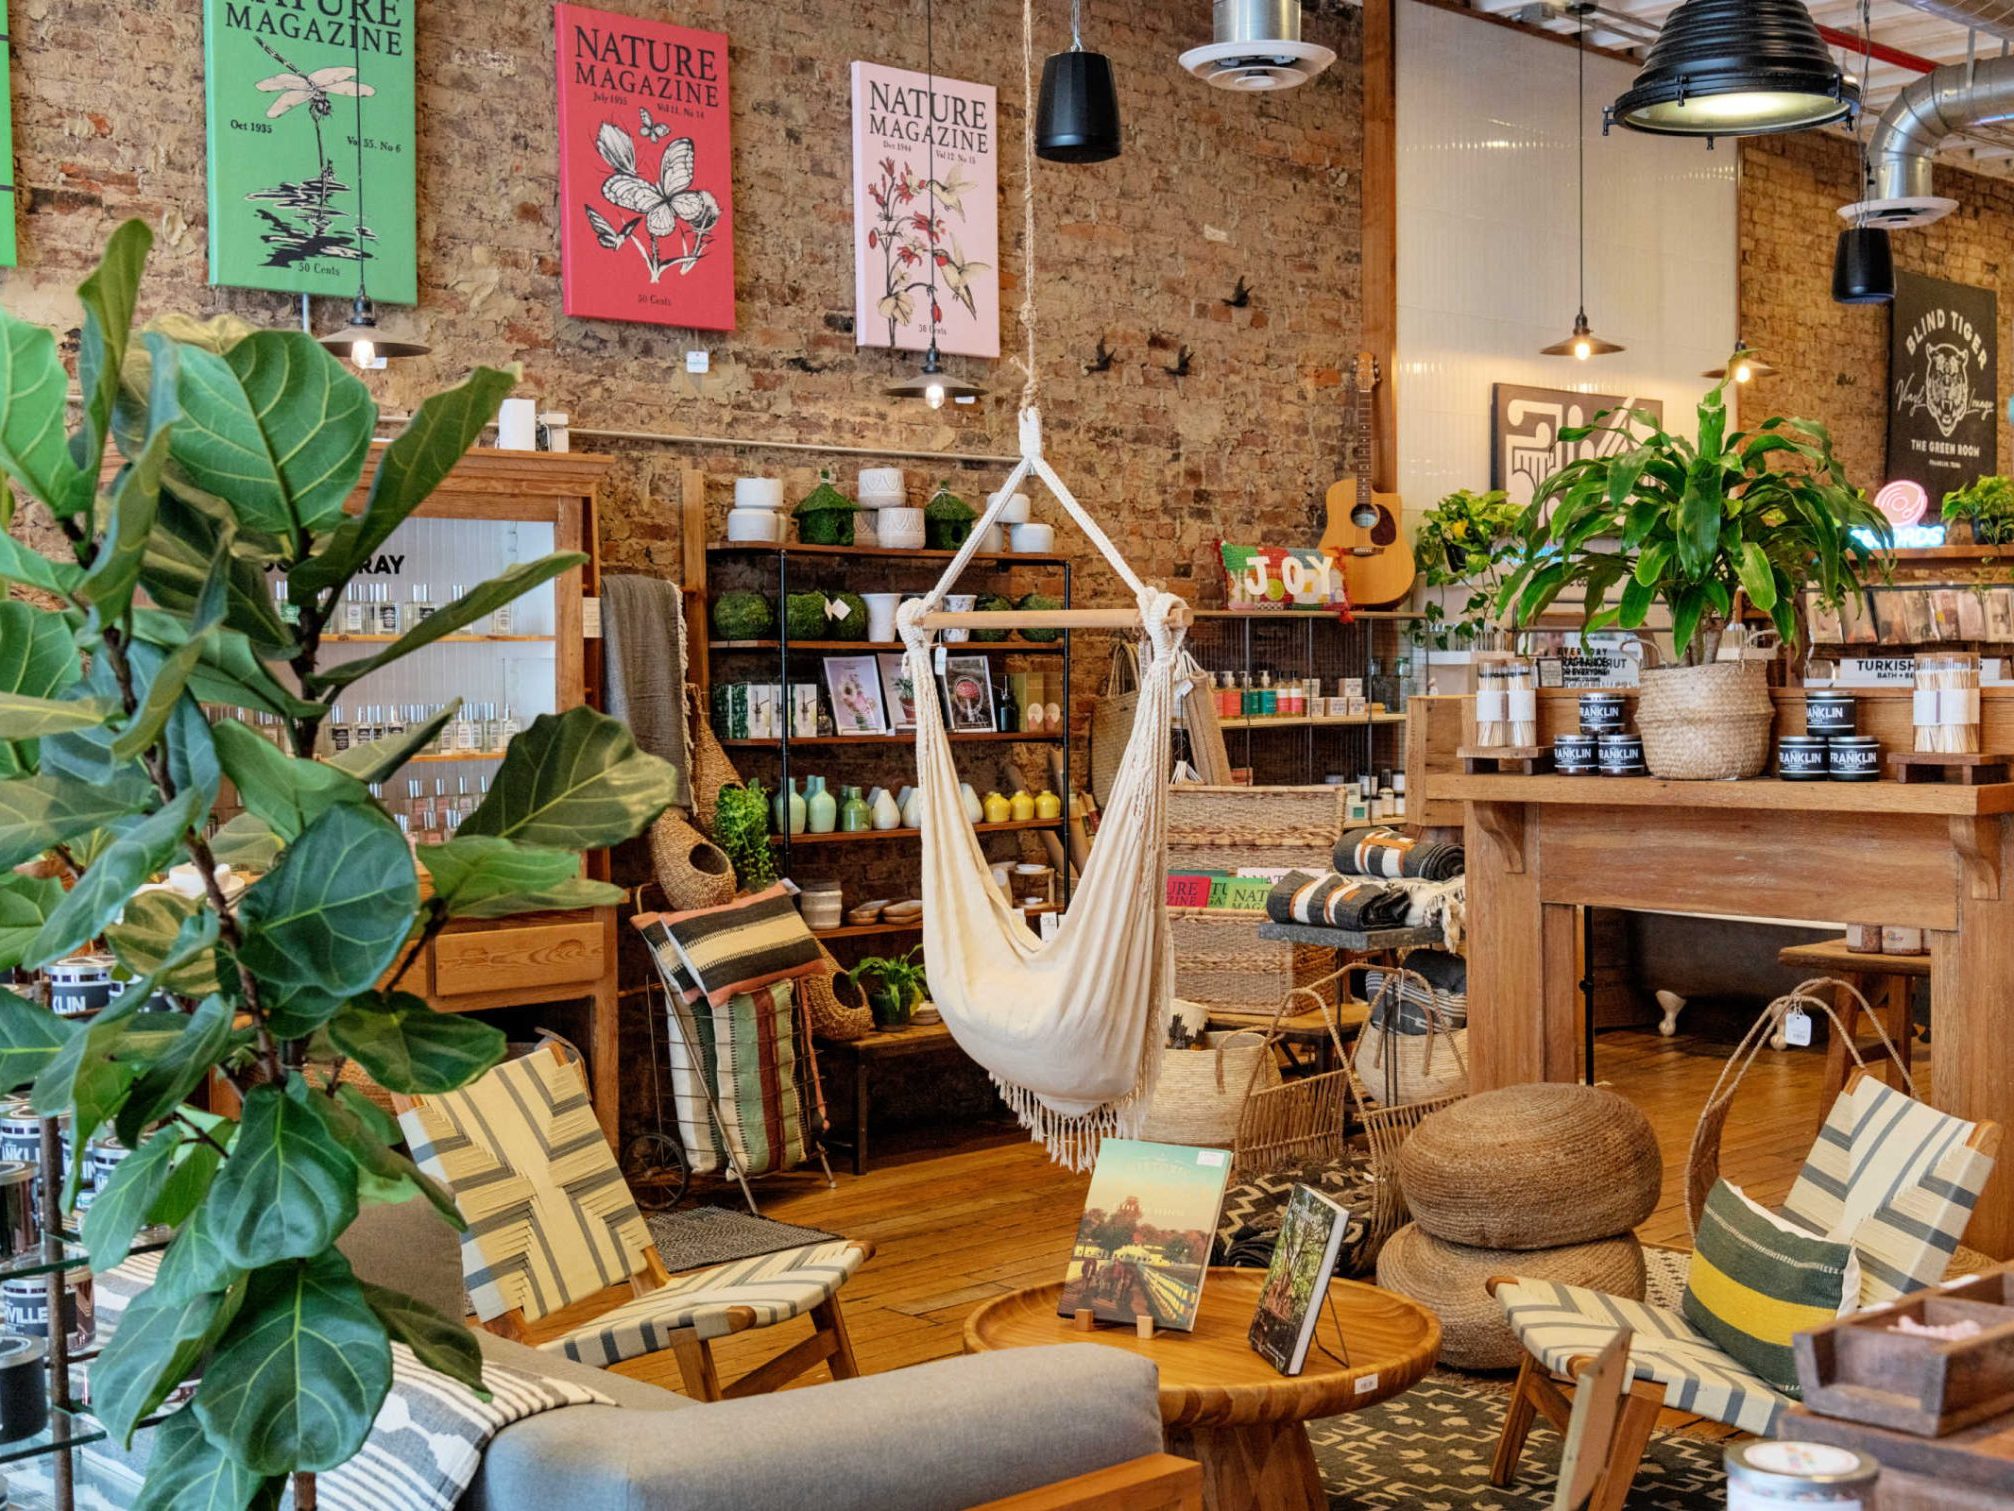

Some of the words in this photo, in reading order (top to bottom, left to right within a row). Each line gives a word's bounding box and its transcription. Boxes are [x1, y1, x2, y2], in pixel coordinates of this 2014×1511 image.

[225, 2, 402, 56] MAGAZINE
[574, 25, 718, 82] NATURE
[575, 62, 719, 108] MAGAZINE
[869, 80, 988, 130] NATURE
[230, 119, 247, 131] Oct
[869, 113, 989, 154] MAGAZINE
[380, 141, 393, 152] No
[314, 264, 340, 277] Cents
[1906, 309, 1946, 356] BLIND
[1950, 310, 1988, 371] TIGER
[1911, 439, 1927, 452] THE
[1928, 441, 1956, 455] GREEN
[1957, 444, 1980, 458] ROOM
[1245, 555, 1334, 596] JOY
[1830, 751, 1877, 764] FRANKLIN
